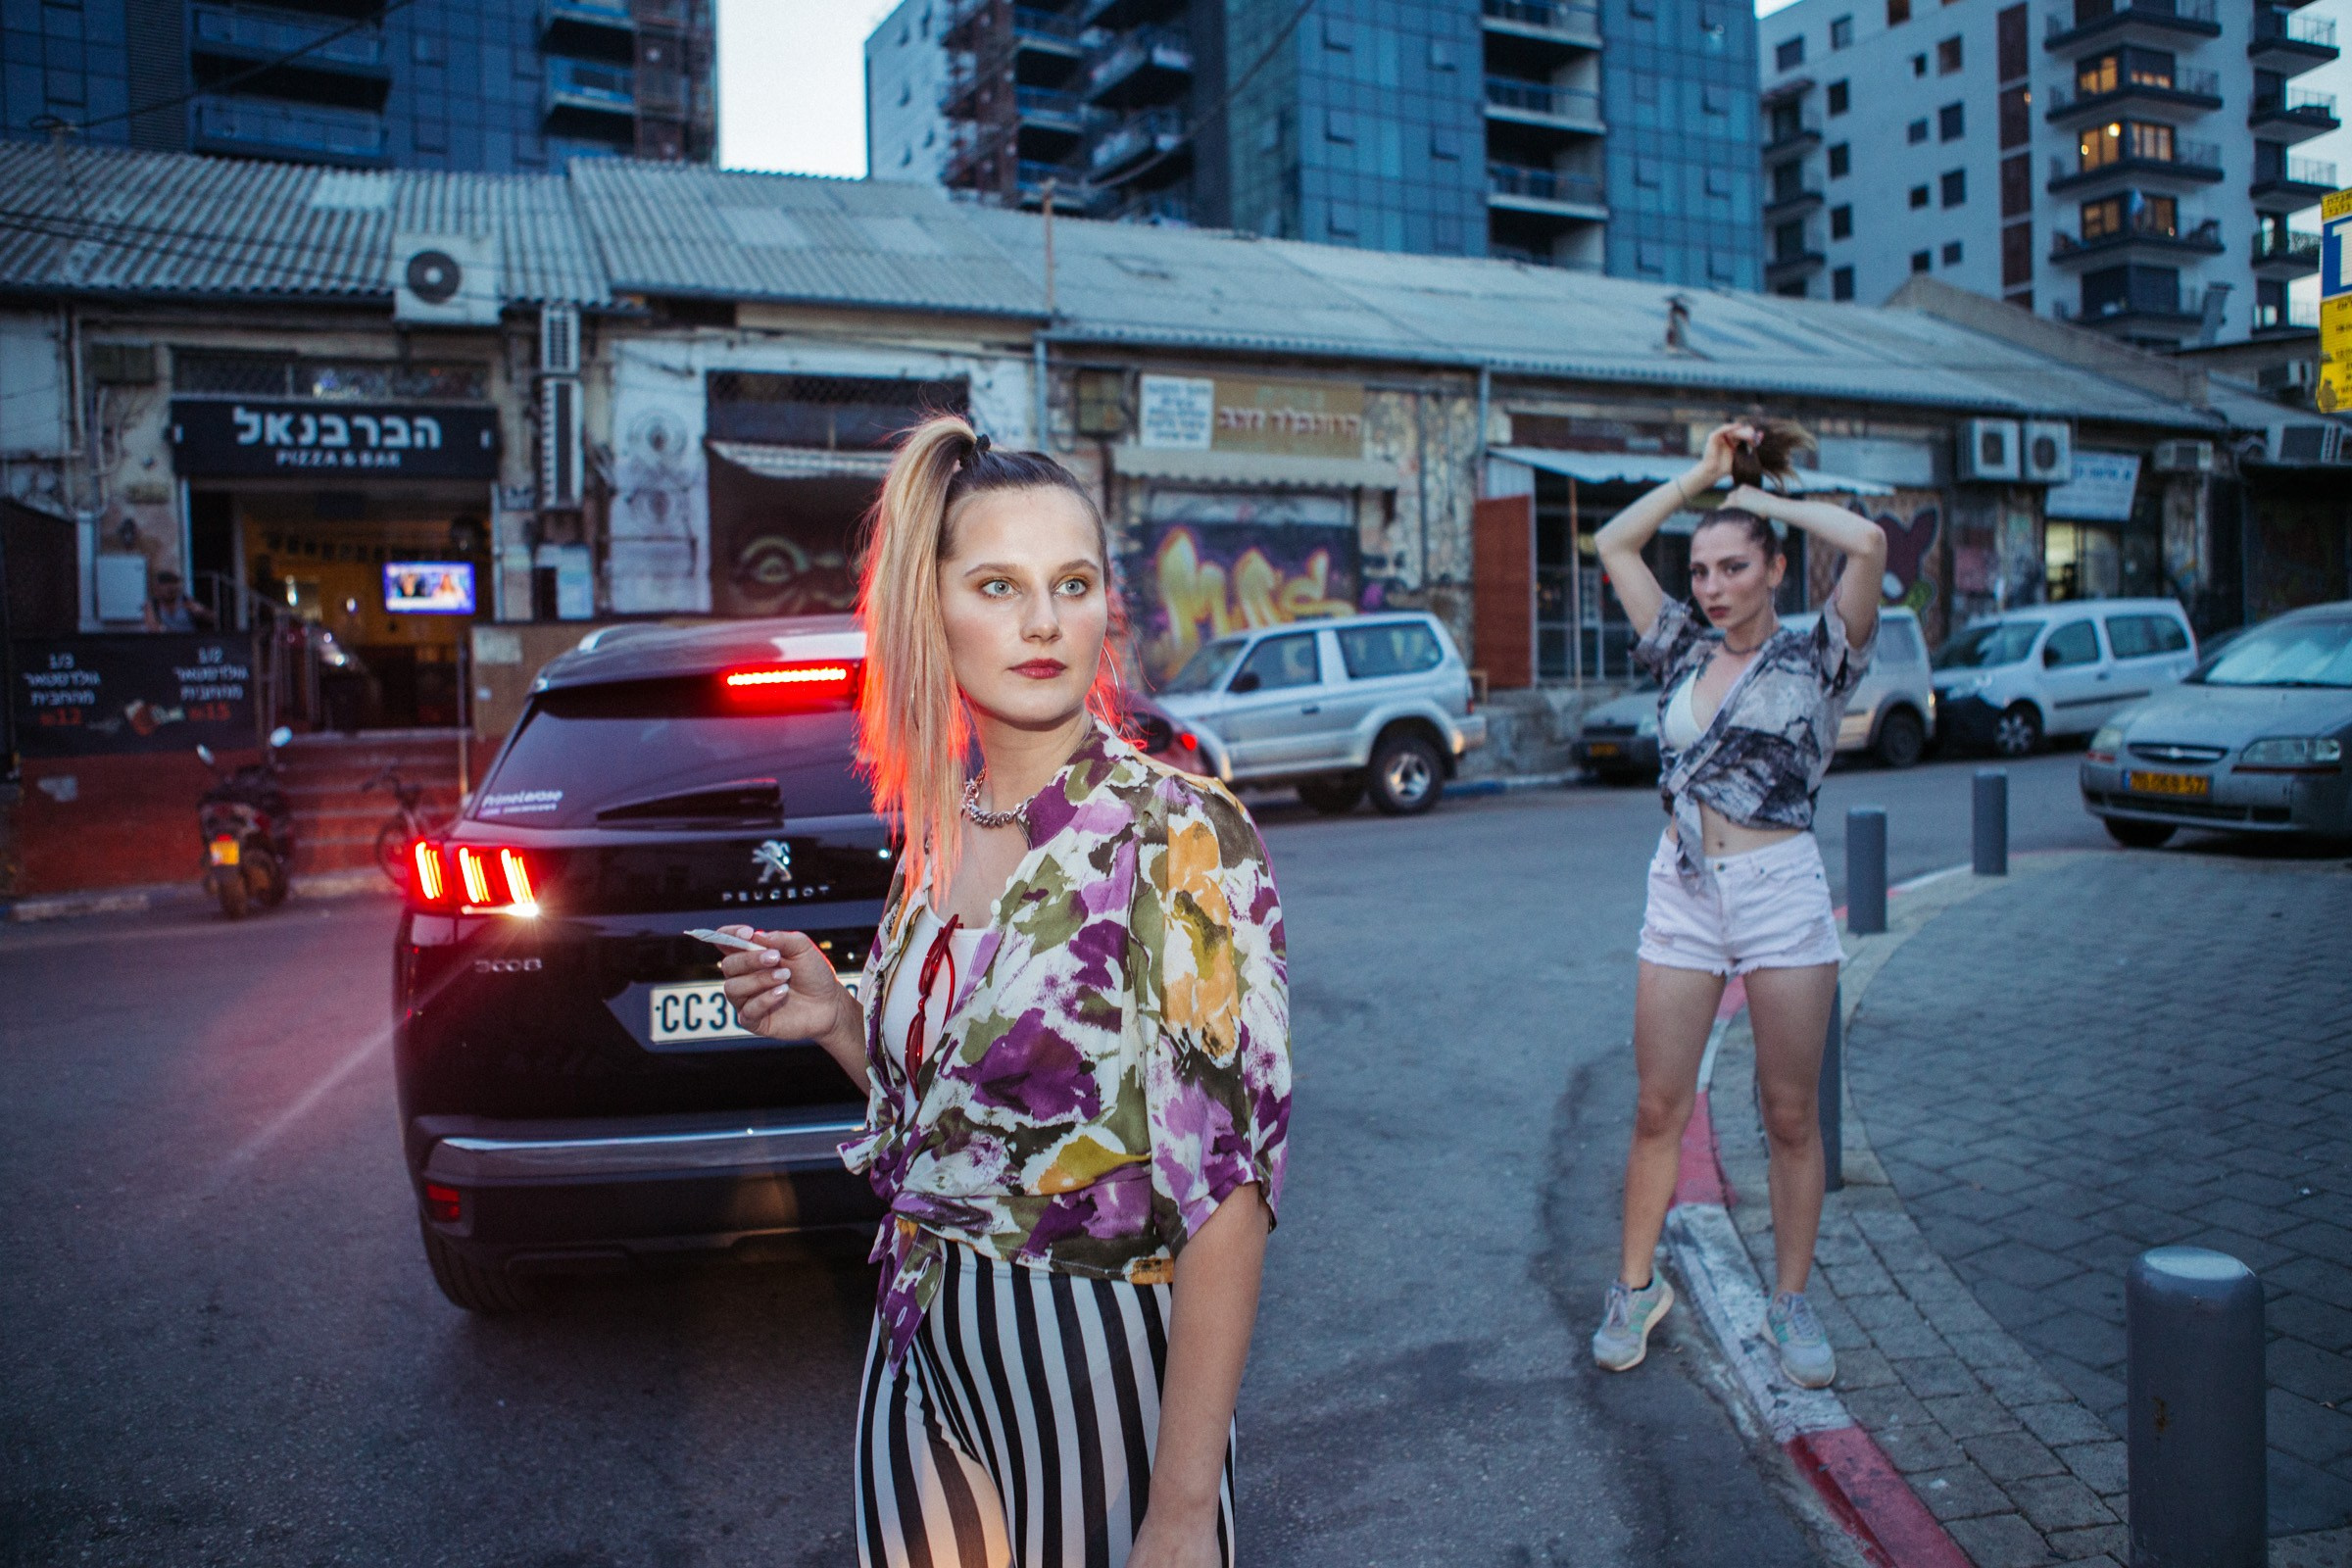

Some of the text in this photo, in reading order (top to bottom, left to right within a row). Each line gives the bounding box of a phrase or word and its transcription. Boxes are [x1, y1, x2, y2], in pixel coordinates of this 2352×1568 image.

[233, 406, 441, 449] הברבנאל
[276, 450, 401, 467] PIZZA & BAR
[722, 884, 830, 903] PEUGEOT
